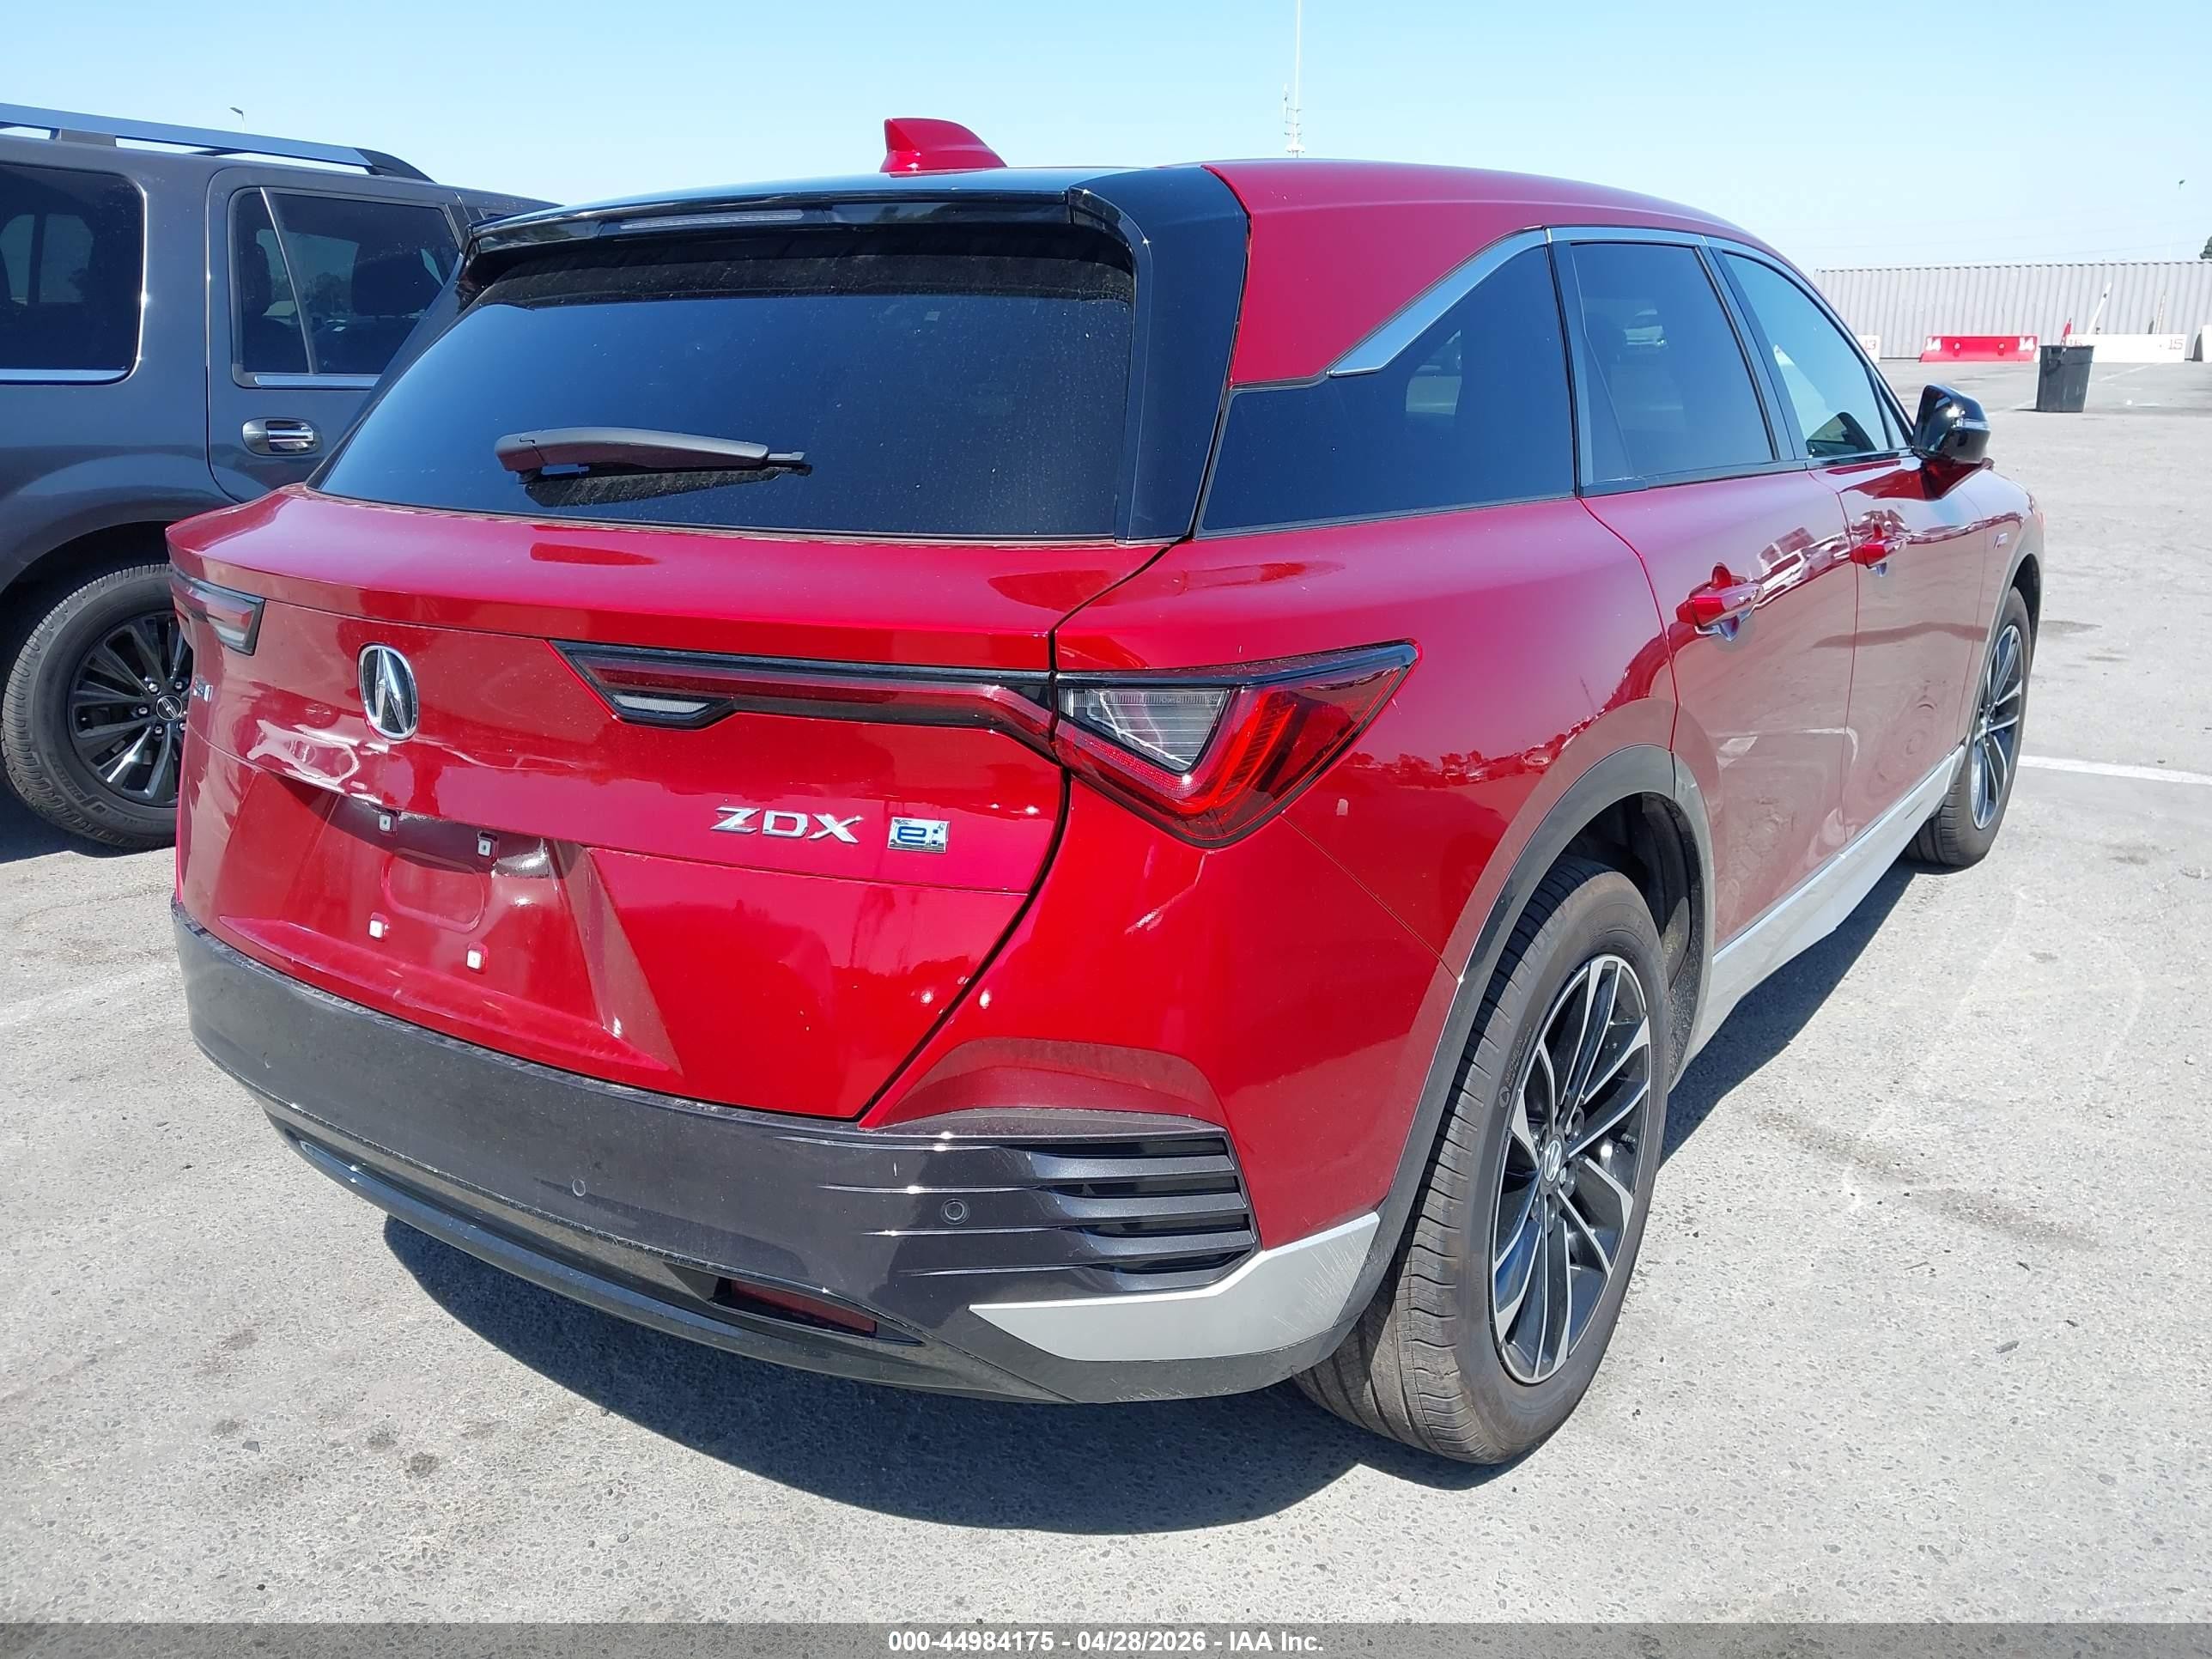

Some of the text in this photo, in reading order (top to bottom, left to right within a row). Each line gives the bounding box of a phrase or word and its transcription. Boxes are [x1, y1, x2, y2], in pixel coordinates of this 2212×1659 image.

[1925, 337, 1942, 350] 14
[2018, 336, 2035, 350] 14
[2168, 338, 2184, 350] 15
[710, 805, 863, 844] ZDX
